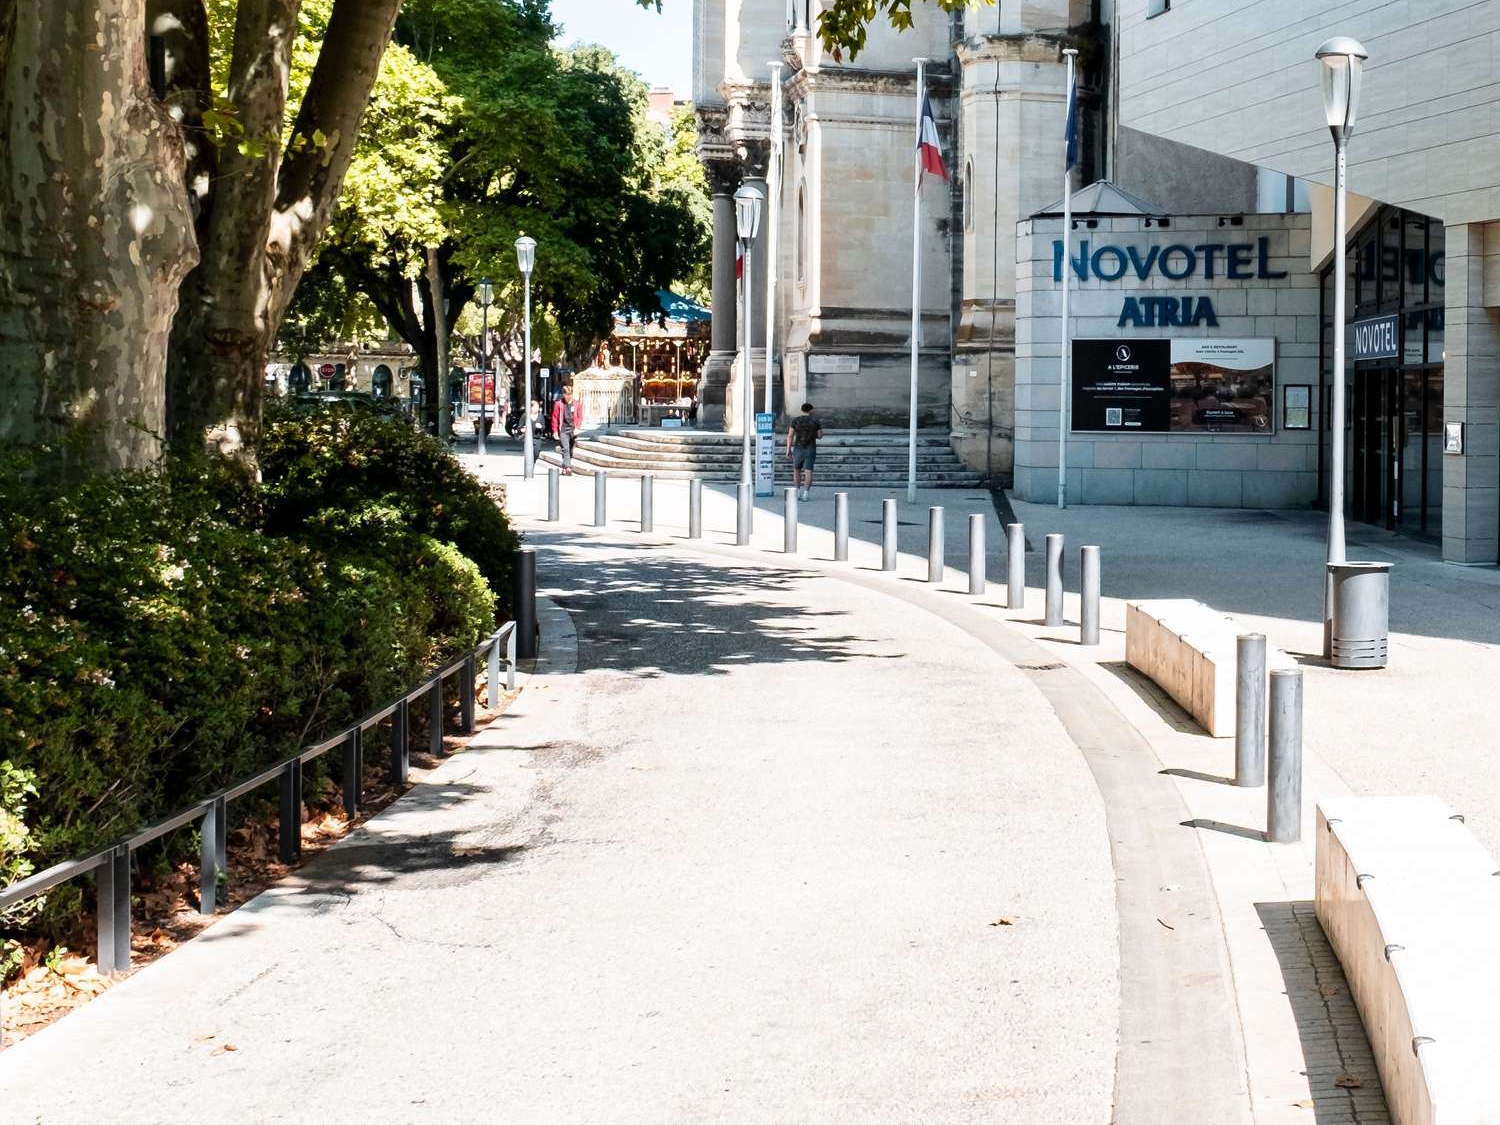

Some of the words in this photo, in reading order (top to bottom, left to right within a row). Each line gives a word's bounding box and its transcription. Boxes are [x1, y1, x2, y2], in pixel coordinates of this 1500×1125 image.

[1052, 236, 1288, 282] NOVOTEL
[1117, 296, 1220, 327] ATRIA
[1355, 321, 1397, 354] NOVOTEL
